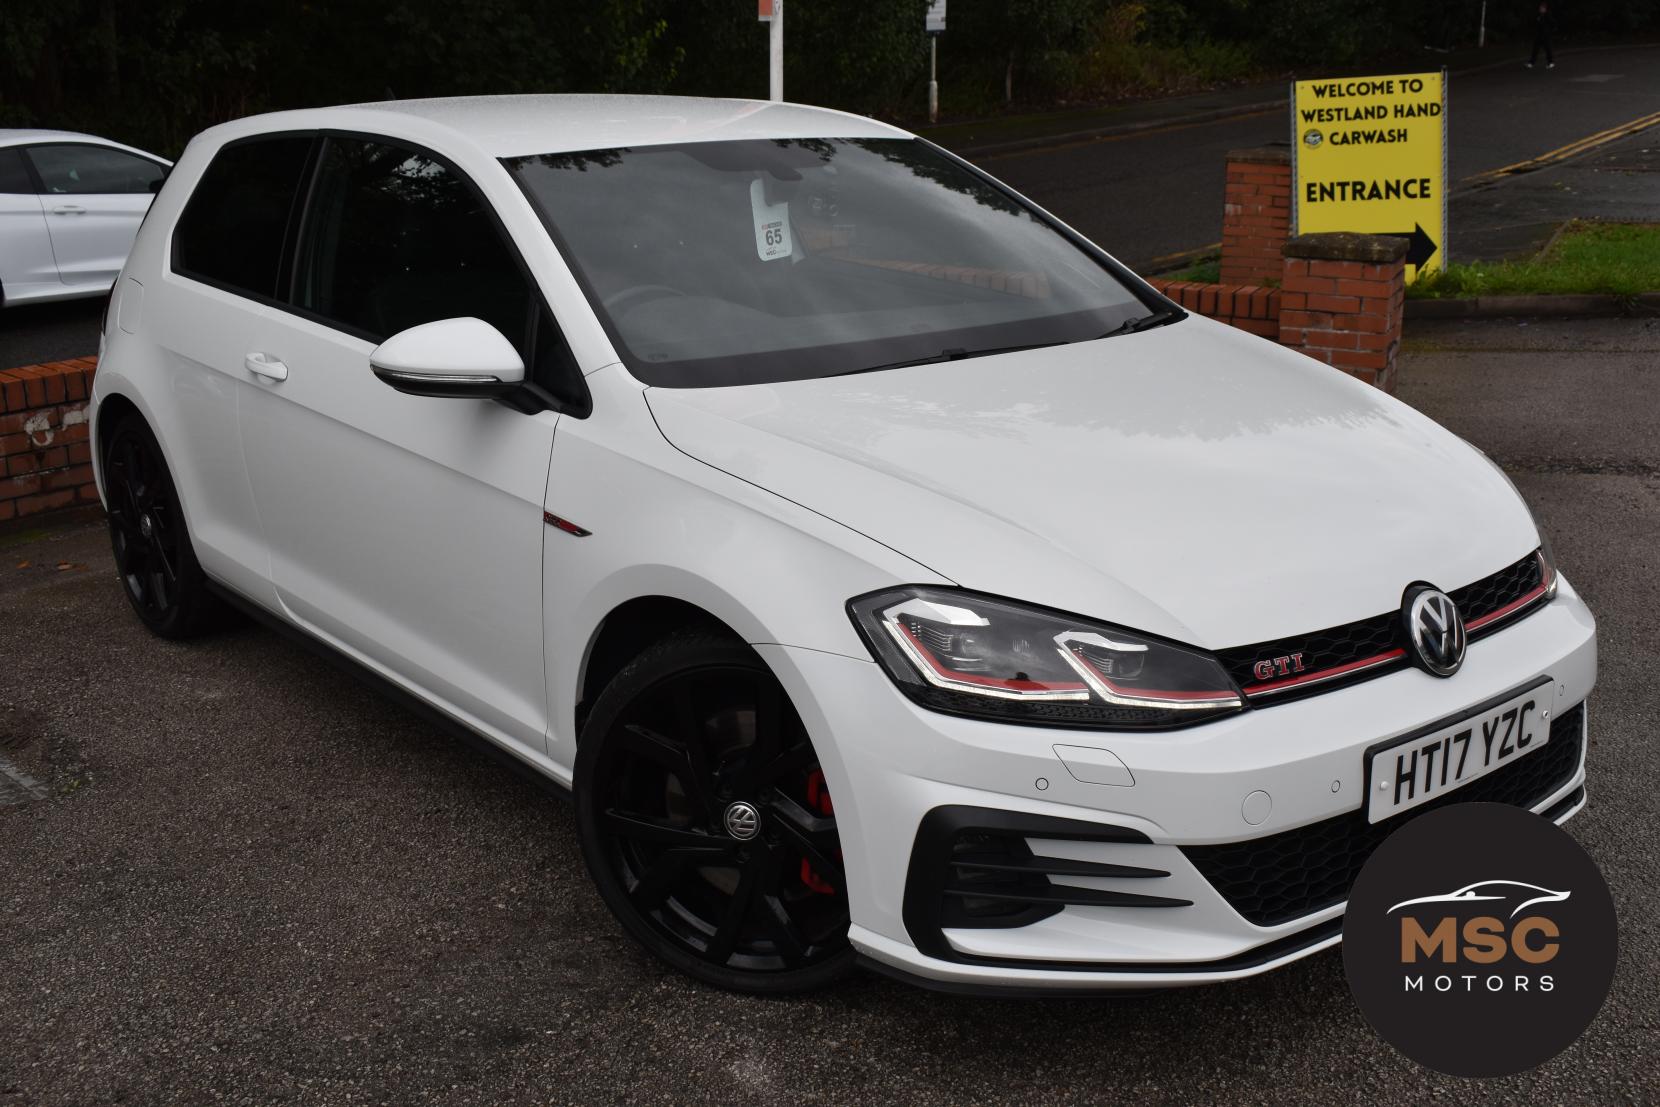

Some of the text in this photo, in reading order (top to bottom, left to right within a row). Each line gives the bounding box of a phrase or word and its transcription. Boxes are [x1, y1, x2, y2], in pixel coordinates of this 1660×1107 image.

[1312, 79, 1423, 98] WELCOME TO
[1301, 102, 1441, 123] WESTLAND HAND
[1329, 128, 1408, 146] CARWASH
[1306, 178, 1431, 202] ENTRANCE
[765, 228, 782, 246] 65
[1253, 652, 1304, 680] GTI
[1393, 699, 1536, 806] HT17 YZC
